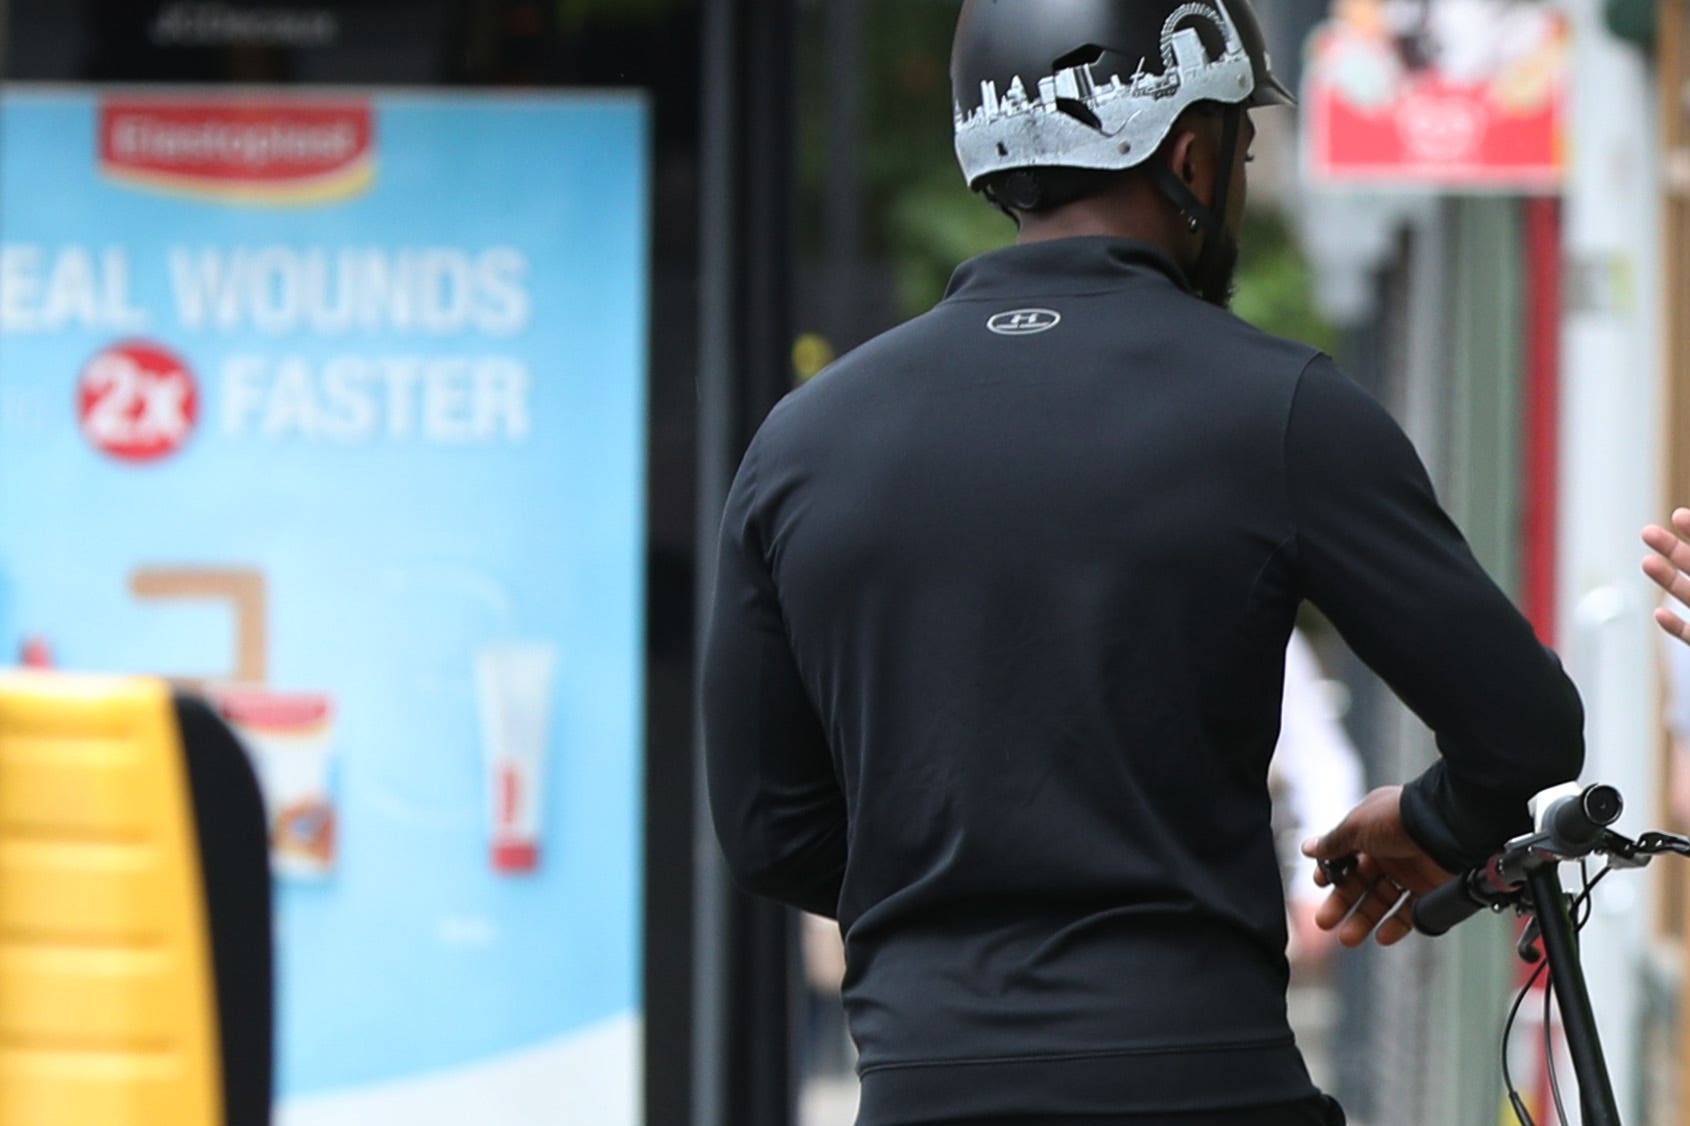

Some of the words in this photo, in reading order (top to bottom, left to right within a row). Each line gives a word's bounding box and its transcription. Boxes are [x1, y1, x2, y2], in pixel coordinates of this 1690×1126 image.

[169, 246, 530, 333] WOUNDS
[84, 350, 188, 446] 2x
[222, 354, 531, 442] FASTER
